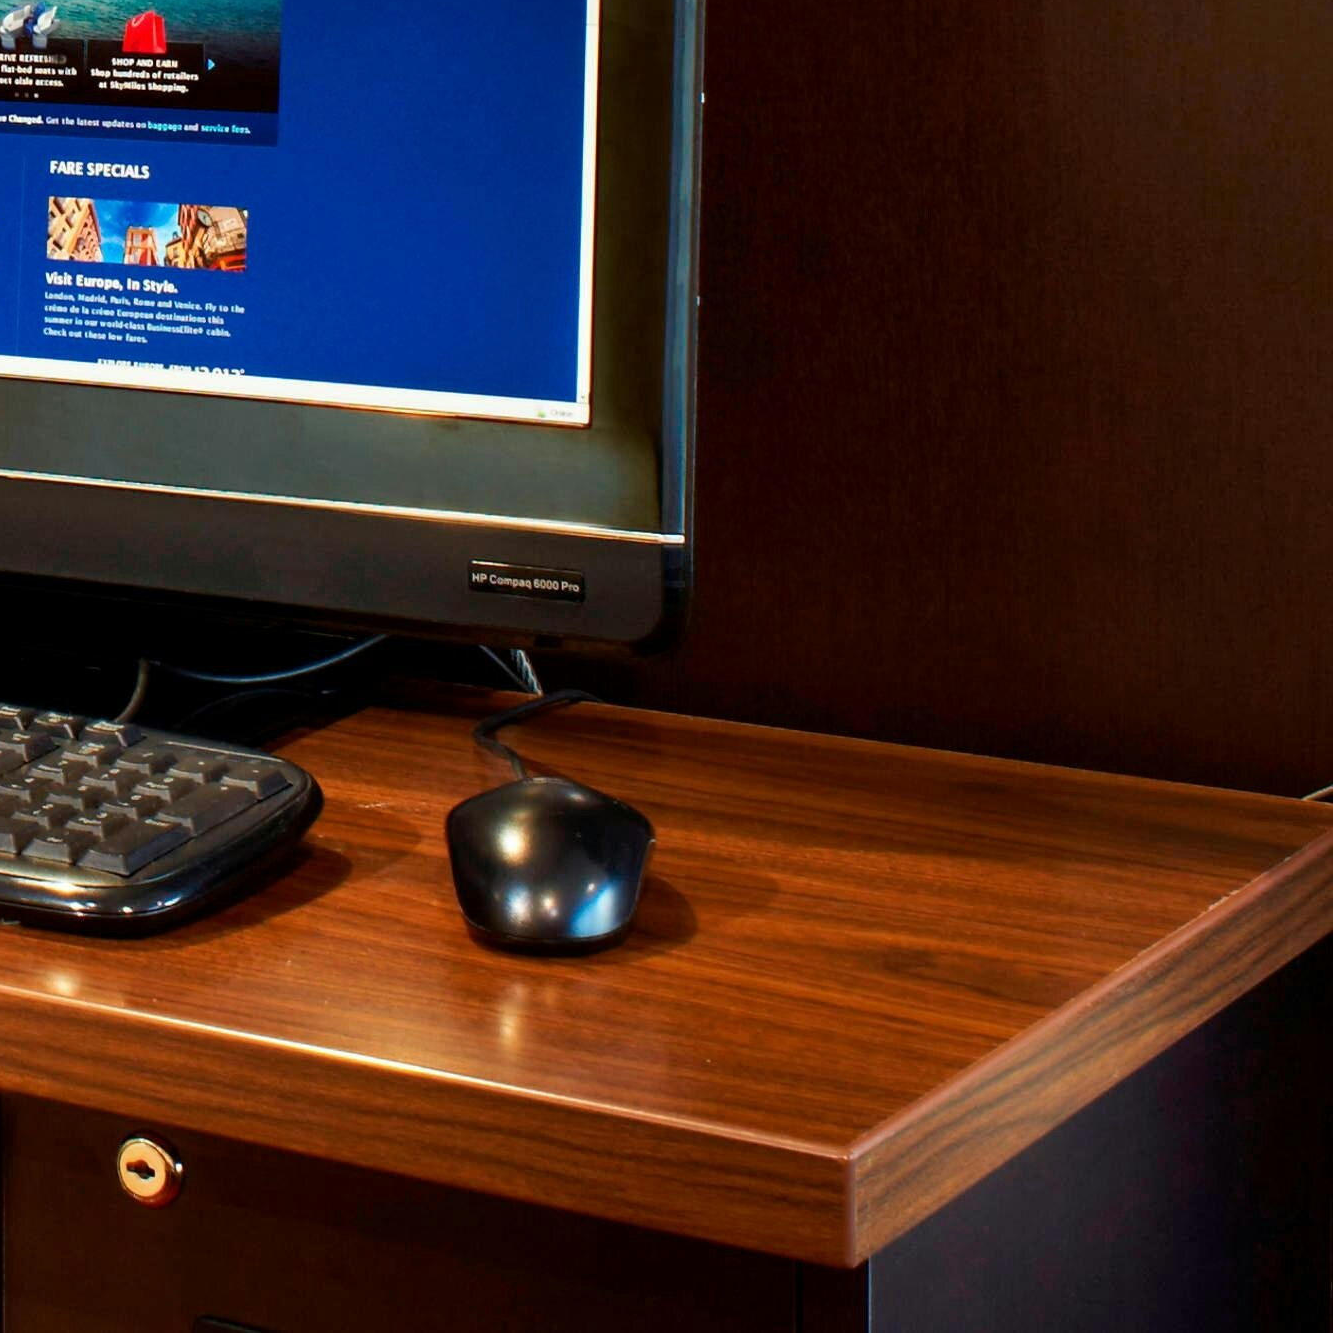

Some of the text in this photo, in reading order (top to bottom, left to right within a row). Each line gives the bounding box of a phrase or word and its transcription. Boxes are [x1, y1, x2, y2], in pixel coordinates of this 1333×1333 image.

[112, 58, 178, 68] SHOP AND EARN
[50, 161, 149, 178] FARE SPECIALS
[46, 272, 178, 293] Visit Europe, In Style.
[472, 573, 579, 592] HP Compaq 6000 Pro
